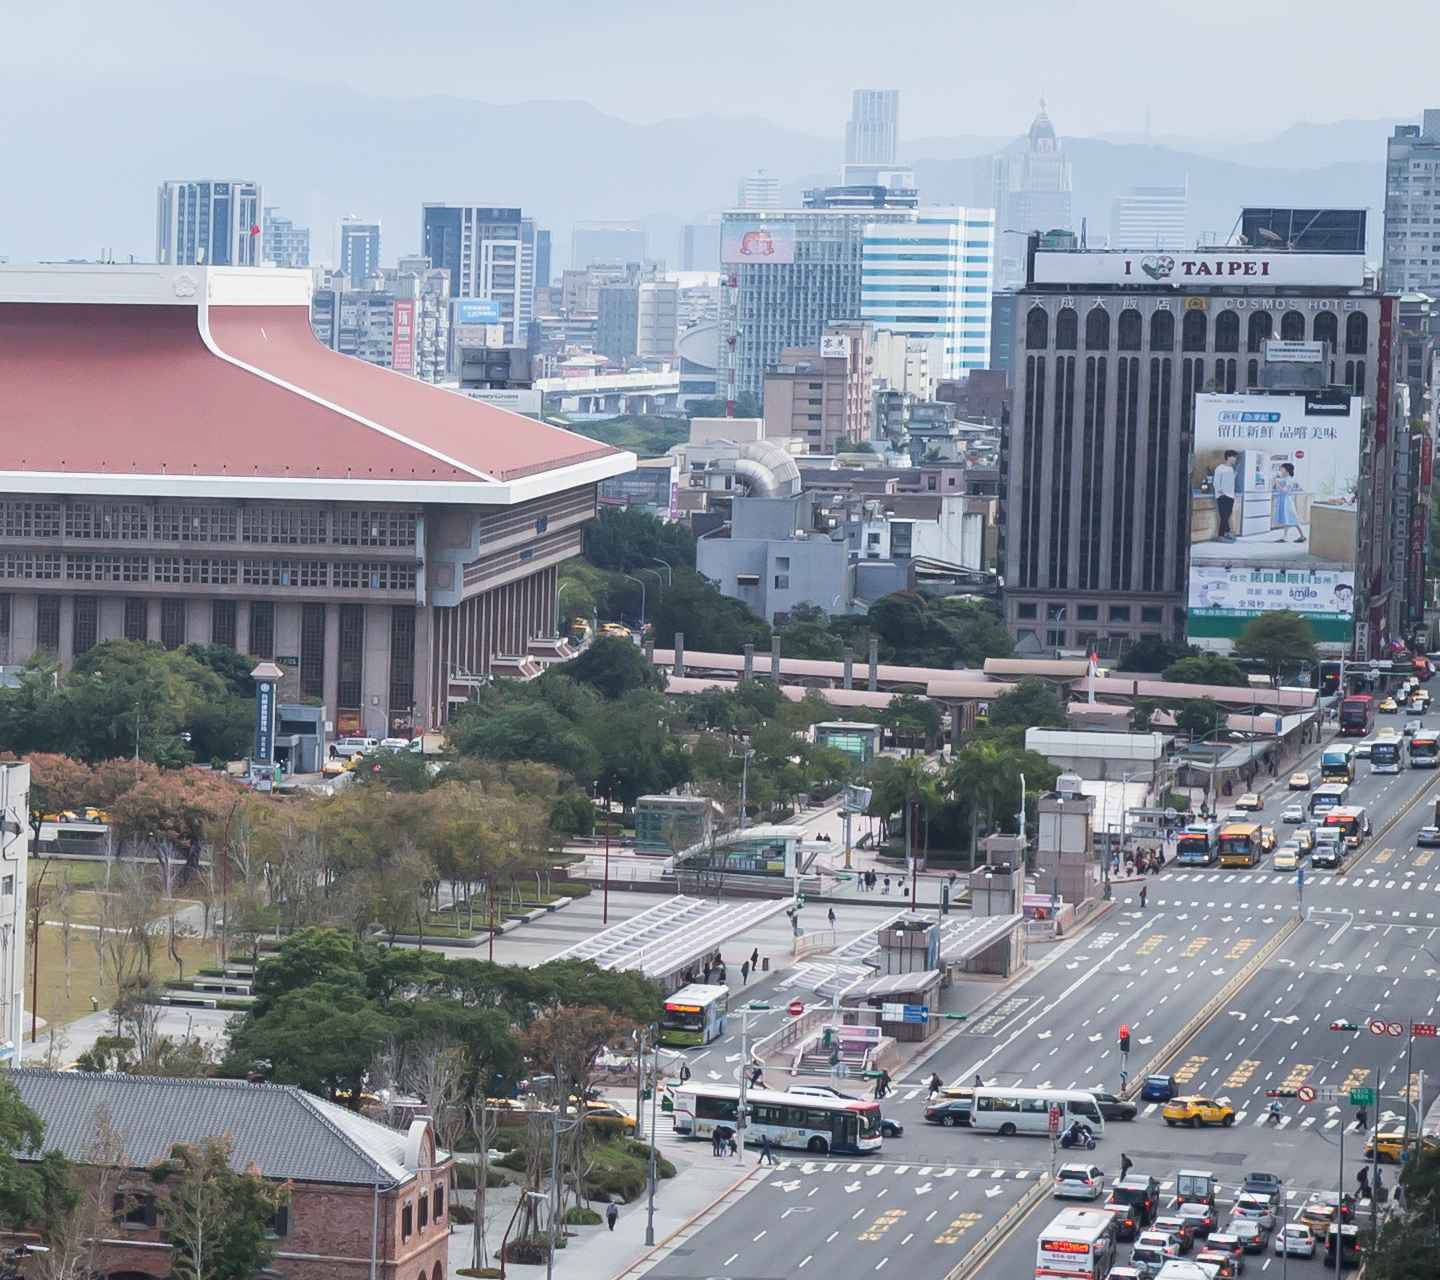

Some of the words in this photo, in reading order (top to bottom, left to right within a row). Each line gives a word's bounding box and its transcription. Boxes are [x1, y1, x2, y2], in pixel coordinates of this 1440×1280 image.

[1124, 260, 1132, 275] I
[1181, 260, 1271, 276] TAIPEI
[1029, 295, 1171, 311] 天成大飯店
[1223, 298, 1299, 310] COSMOS
[1308, 299, 1364, 310] HOTEL
[1307, 402, 1348, 410] Panasonic
[1217, 425, 1275, 439] 留住新鮮
[1289, 586, 1318, 598] smile
